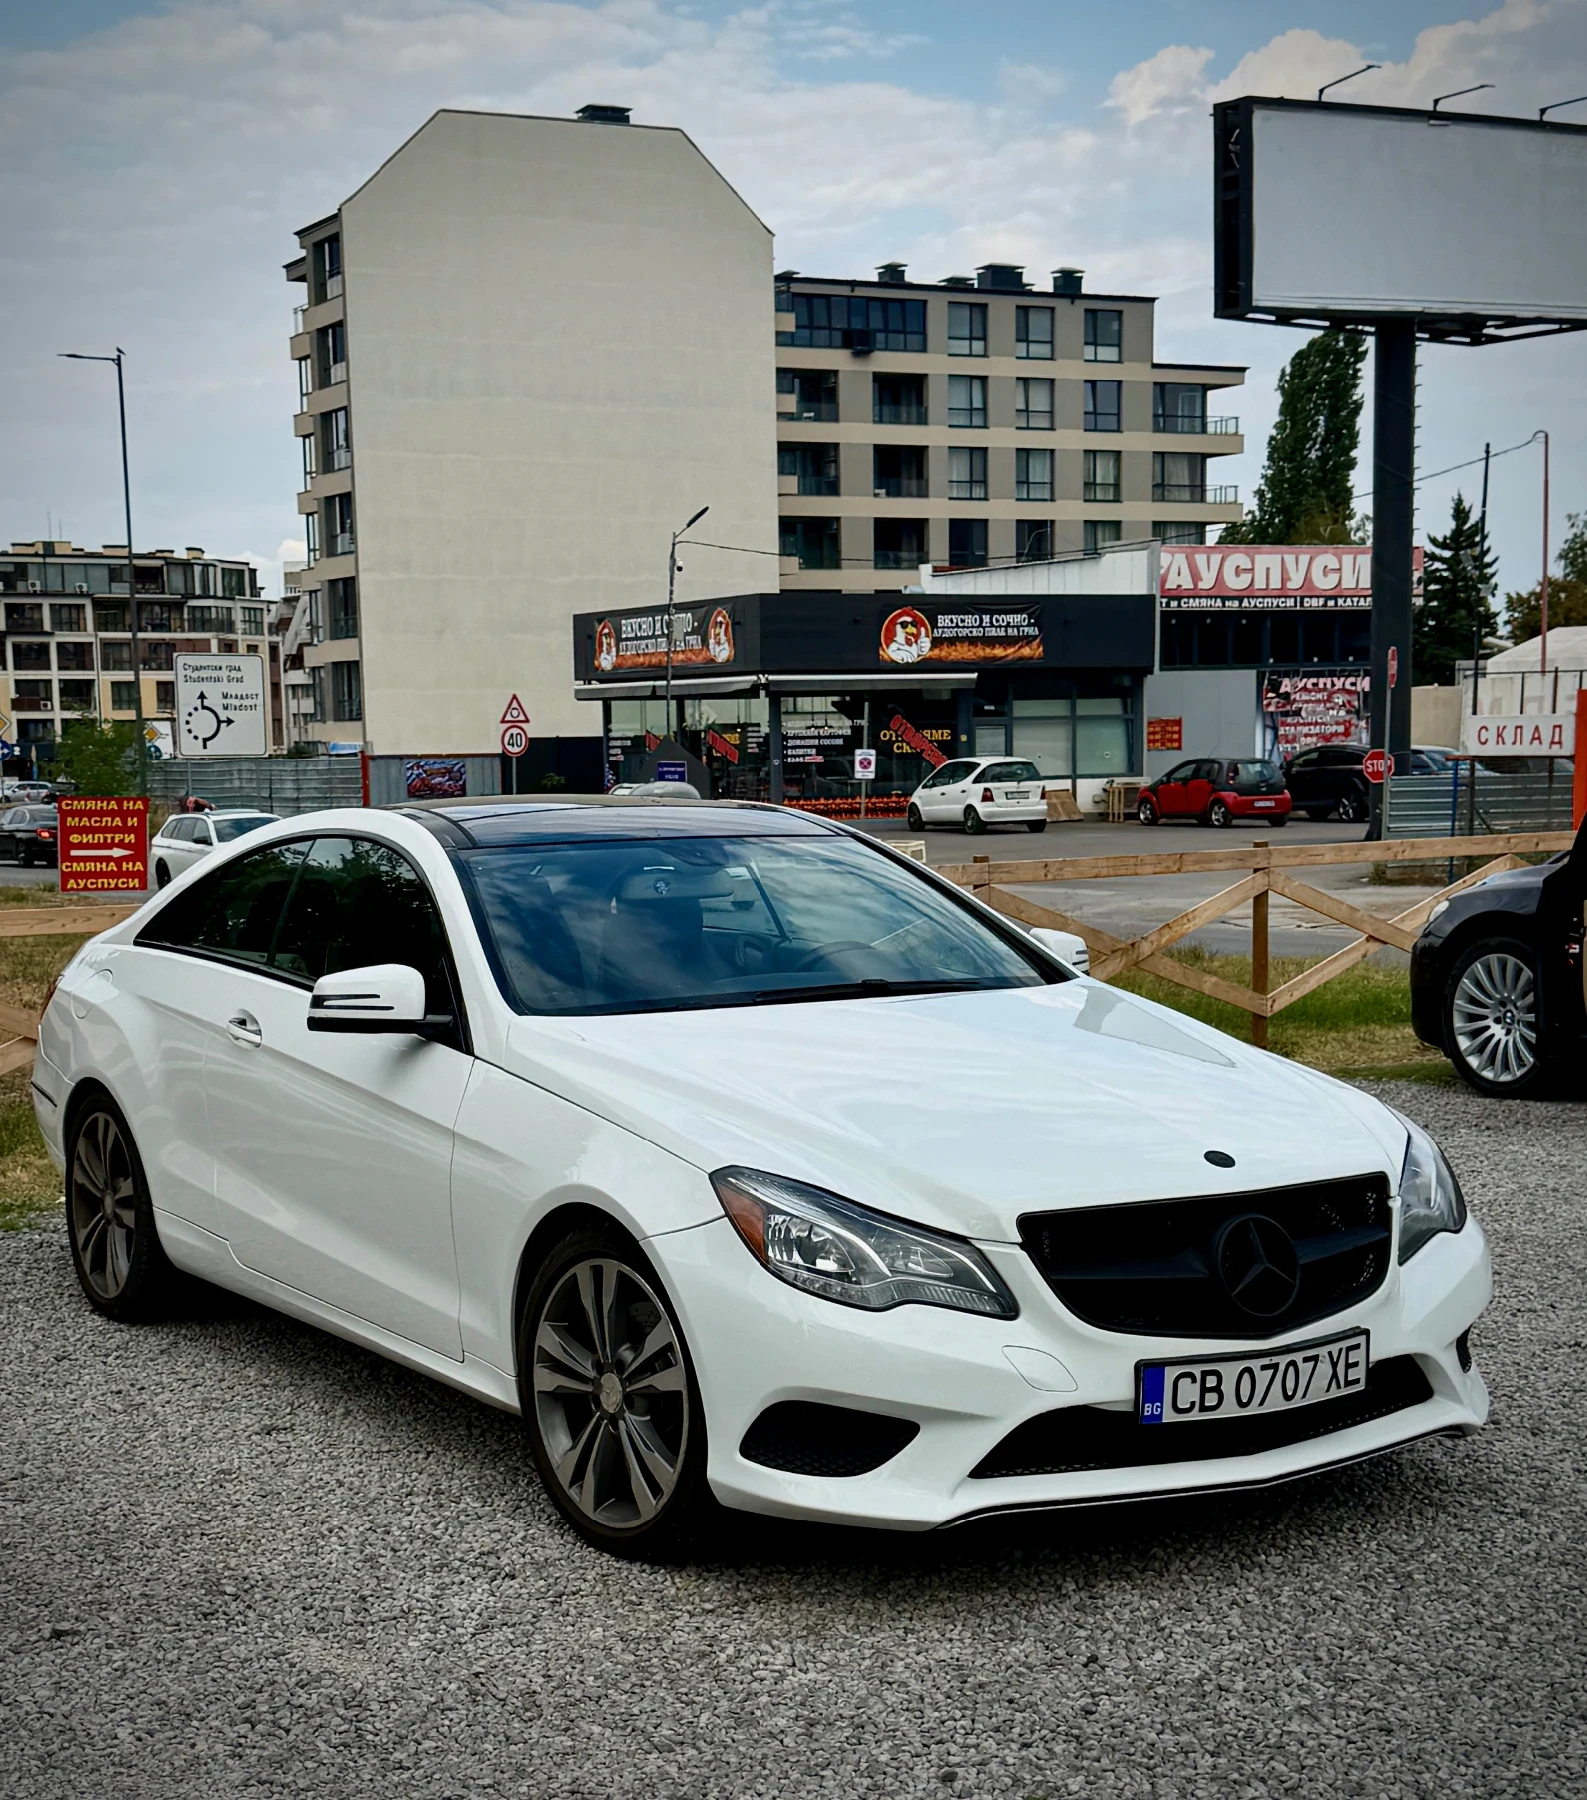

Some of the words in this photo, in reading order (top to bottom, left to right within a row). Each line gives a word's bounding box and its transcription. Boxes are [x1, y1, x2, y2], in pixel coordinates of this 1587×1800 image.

[1164, 552, 1372, 591] АУСПУСИ
[1180, 598, 1222, 608] СМЯНА
[1242, 598, 1295, 608] АУСПУСИ
[938, 614, 980, 626] ВКУСНО
[982, 614, 990, 626] И
[992, 614, 1028, 626] СОЧНО
[182, 663, 222, 673] Студентски
[184, 674, 224, 683] Studentski
[226, 675, 244, 683] Grad
[222, 692, 259, 700] Младост
[222, 703, 258, 711] Mladost
[507, 732, 523, 748] 40
[1477, 724, 1563, 750] СКЛАД
[61, 800, 118, 810] СМЯНА
[123, 800, 144, 810] НА
[66, 816, 122, 826] МАСЛА
[128, 816, 138, 826] И
[69, 834, 136, 844] ФИЛТРИ
[61, 862, 118, 872] СМЯНА
[122, 862, 144, 872] НА
[66, 878, 140, 889] АУСПУСИ
[1172, 1368, 1224, 1415] CB
[1234, 1354, 1321, 1409] 0707
[1324, 1342, 1362, 1394] XE
[1143, 1402, 1162, 1416] BG
